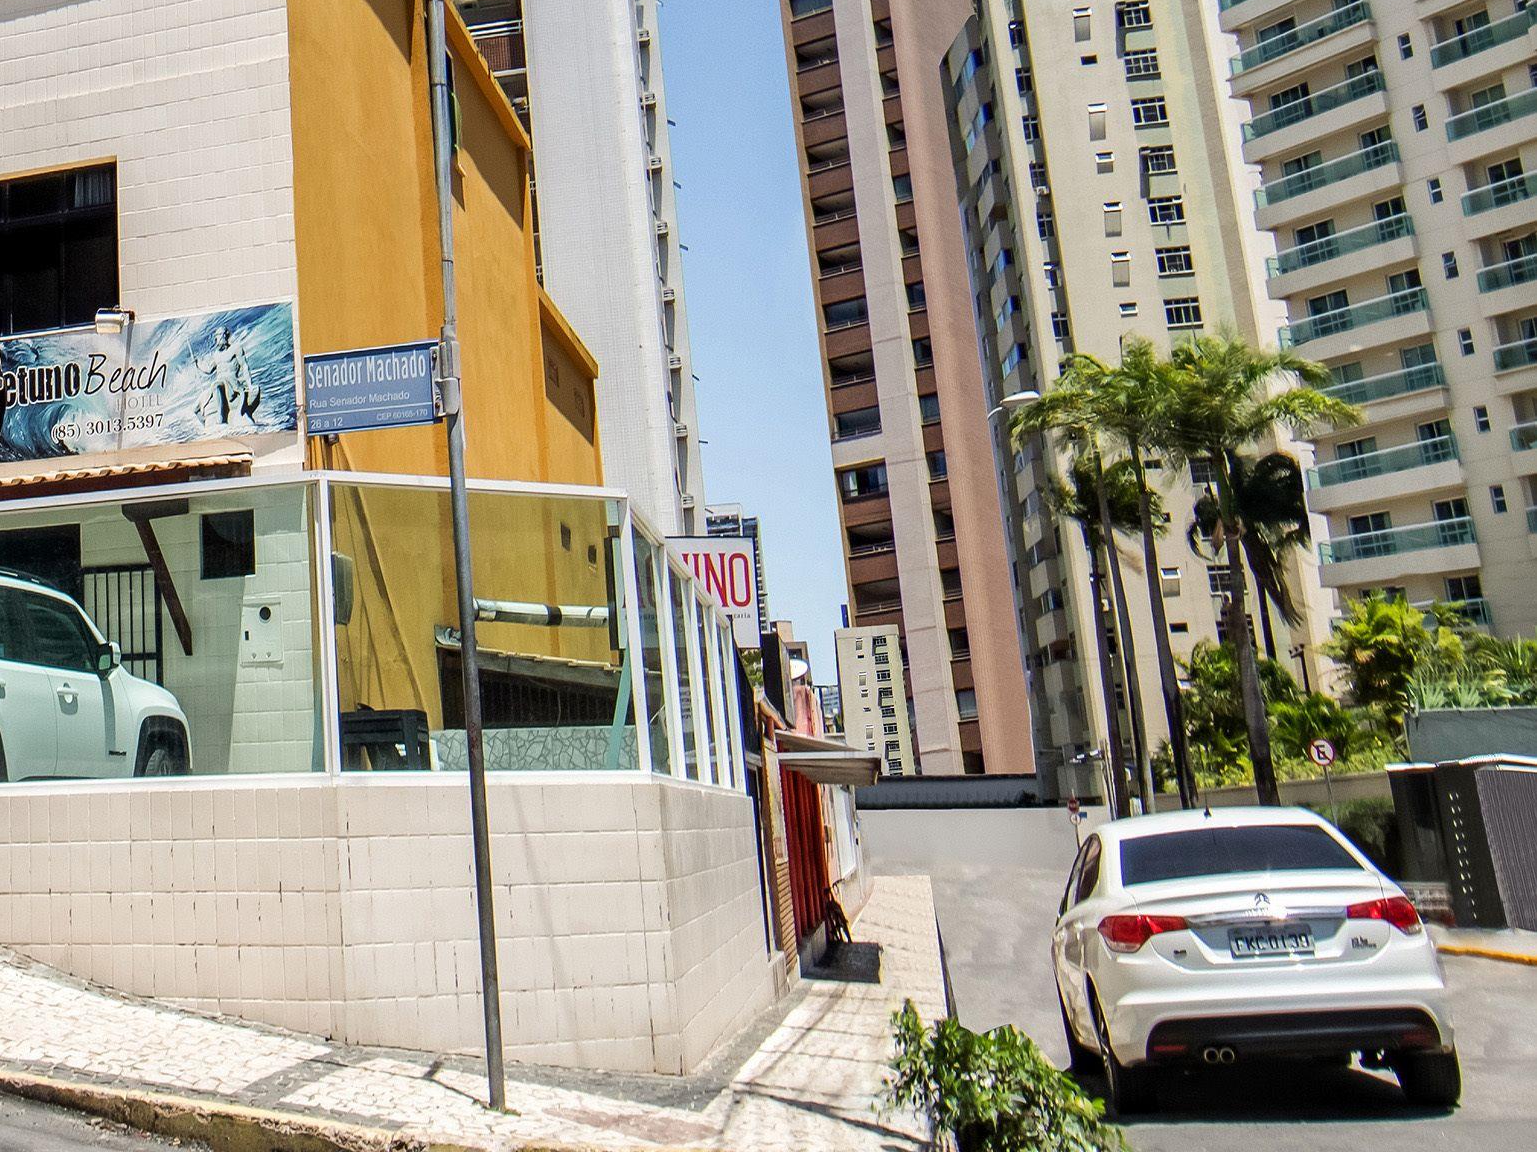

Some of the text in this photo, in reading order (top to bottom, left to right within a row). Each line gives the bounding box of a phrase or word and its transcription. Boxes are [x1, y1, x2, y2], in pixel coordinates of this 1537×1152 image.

[3, 350, 167, 409] etuno Beach
[307, 350, 426, 390] Senador Machado
[309, 389, 410, 409] Rua Senador Machado
[51, 413, 164, 444] (85) 3013.5397
[310, 418, 322, 429] 26
[332, 416, 344, 427] 12
[376, 411, 392, 421] CEP
